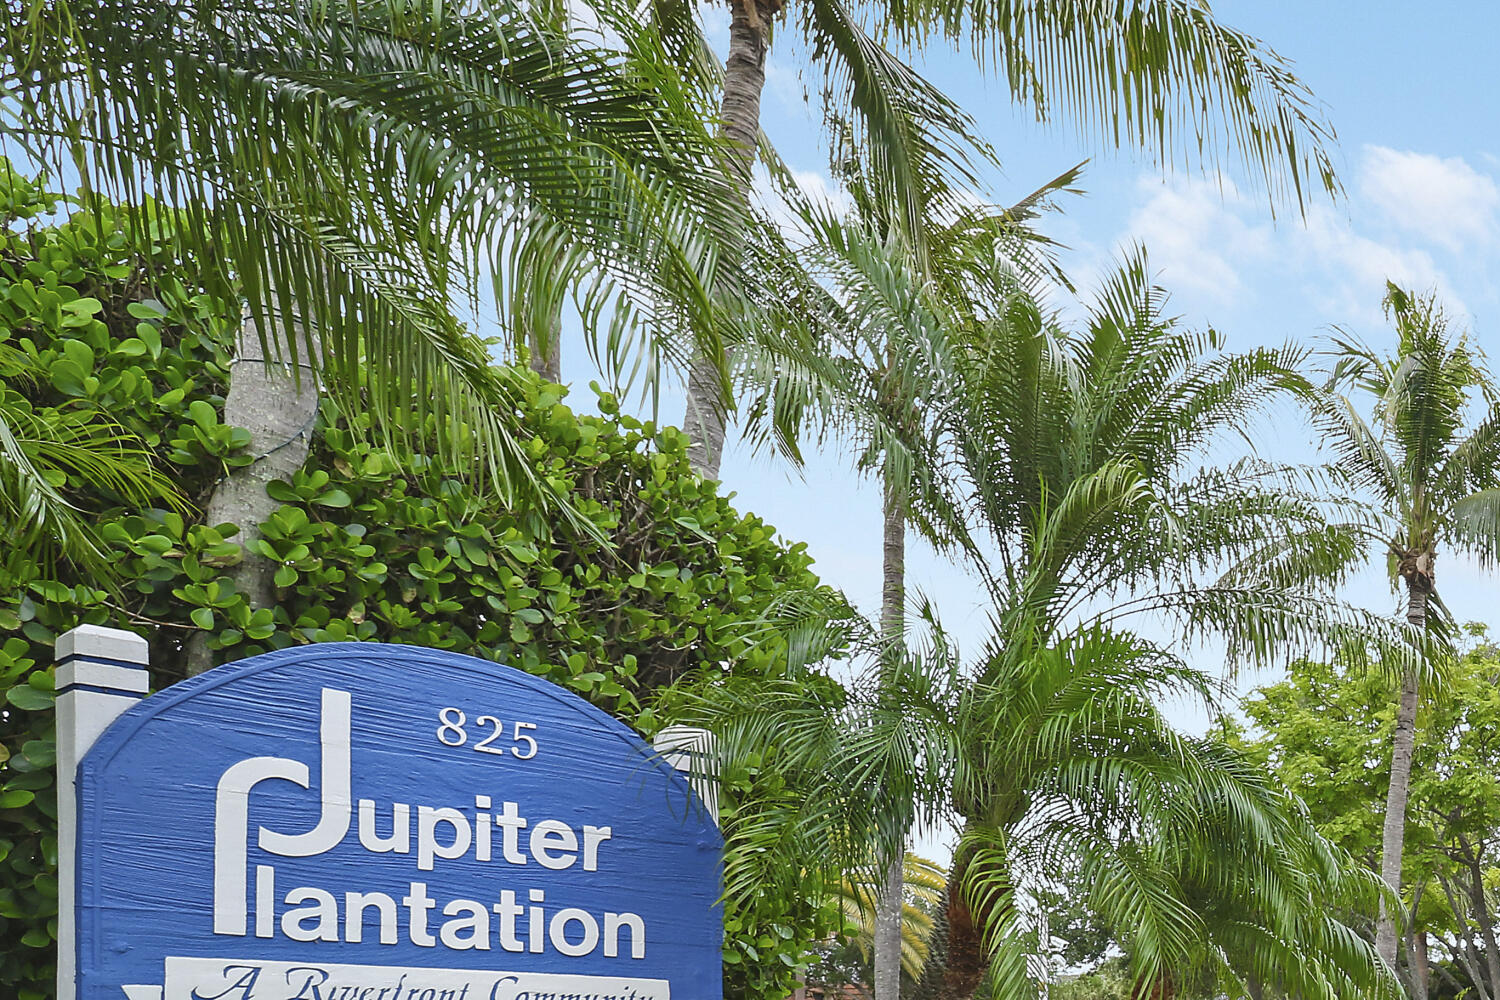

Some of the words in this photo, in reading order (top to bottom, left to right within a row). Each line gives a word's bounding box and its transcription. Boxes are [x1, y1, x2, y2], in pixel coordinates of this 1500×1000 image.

[258, 688, 612, 872] Jupiter
[436, 706, 539, 761] 825
[213, 756, 646, 960] Plantation
